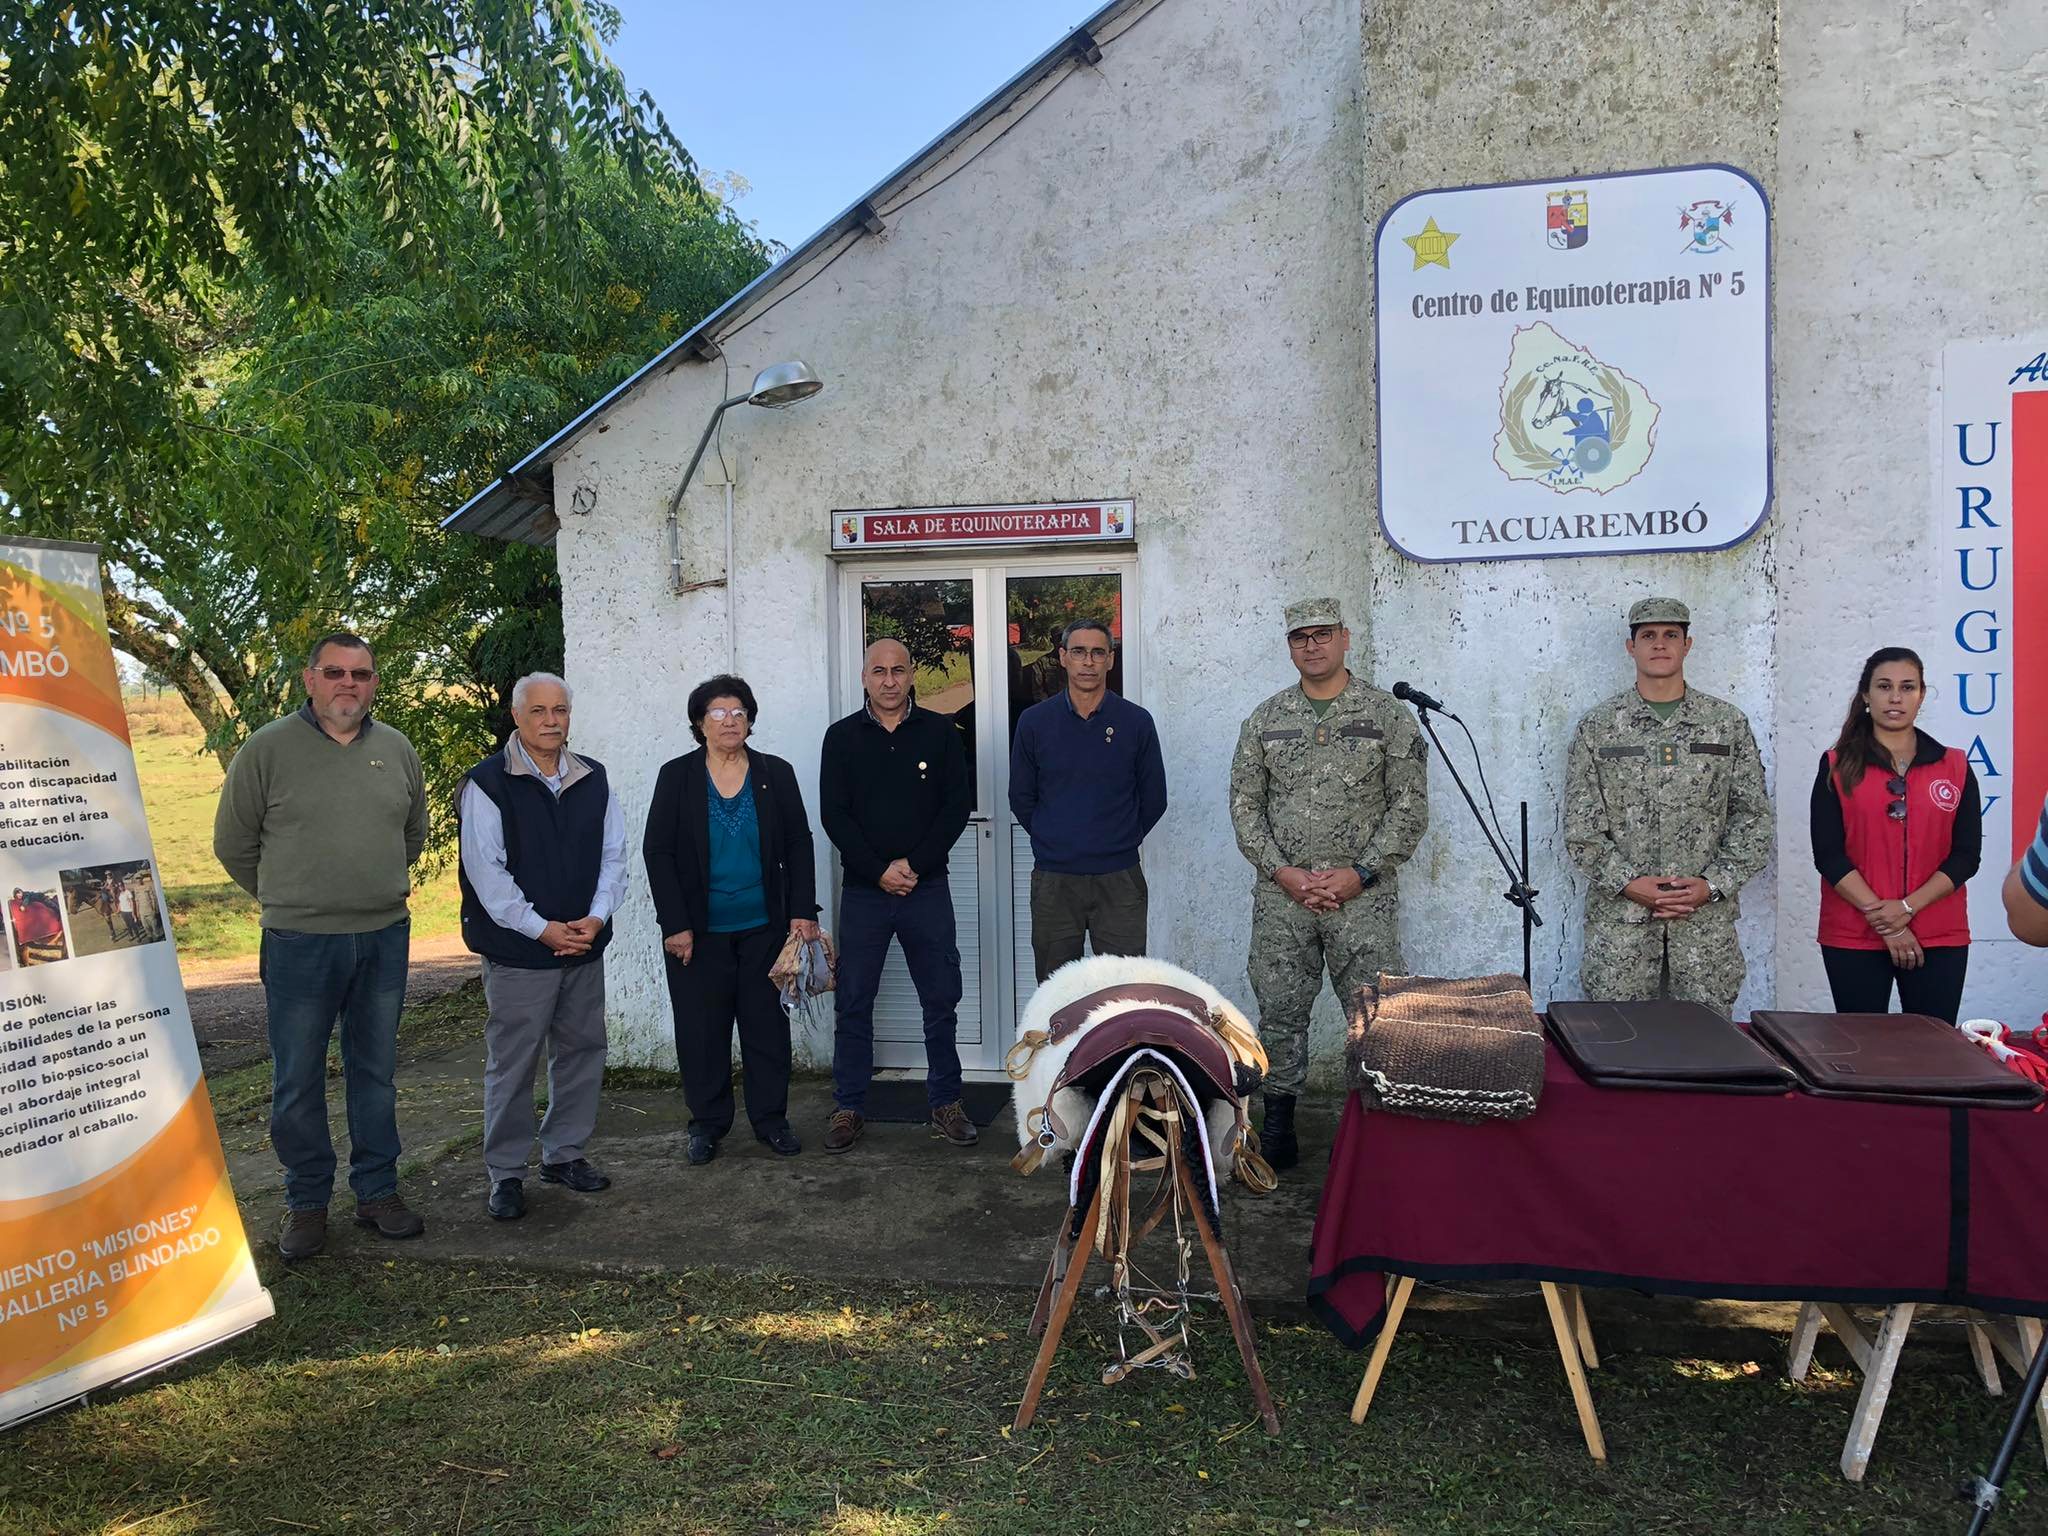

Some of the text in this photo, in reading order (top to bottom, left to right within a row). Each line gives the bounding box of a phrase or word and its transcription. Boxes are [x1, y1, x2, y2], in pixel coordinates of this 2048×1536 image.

[1412, 270, 1745, 318] Centro de Equinoterapia Nº 5
[872, 511, 1091, 537] SALA DE EQUINOTERAPIA
[1451, 501, 1708, 544] TACUAREMBÓ
[39, 615, 55, 639] 5
[0, 771, 117, 790] con discapacidad
[9, 793, 88, 809] alternativa,
[0, 811, 109, 829] eficaz en el área
[10, 831, 84, 848] educación.
[2, 1000, 117, 1032] de potenciar las
[77, 1024, 95, 1036] de
[98, 1020, 112, 1031] la
[115, 1007, 171, 1029] persona
[0, 1031, 147, 1075] idad apostando a un
[0, 1047, 149, 1095] rollo bio-psico-social
[0, 1069, 141, 1116] el abordaje integral
[79, 1089, 147, 1115] utilizando
[68, 1126, 80, 1139] al
[83, 1112, 138, 1134] caballo.
[108, 1226, 221, 1283] BLINDADO
[57, 1299, 109, 1332] Nº 5
